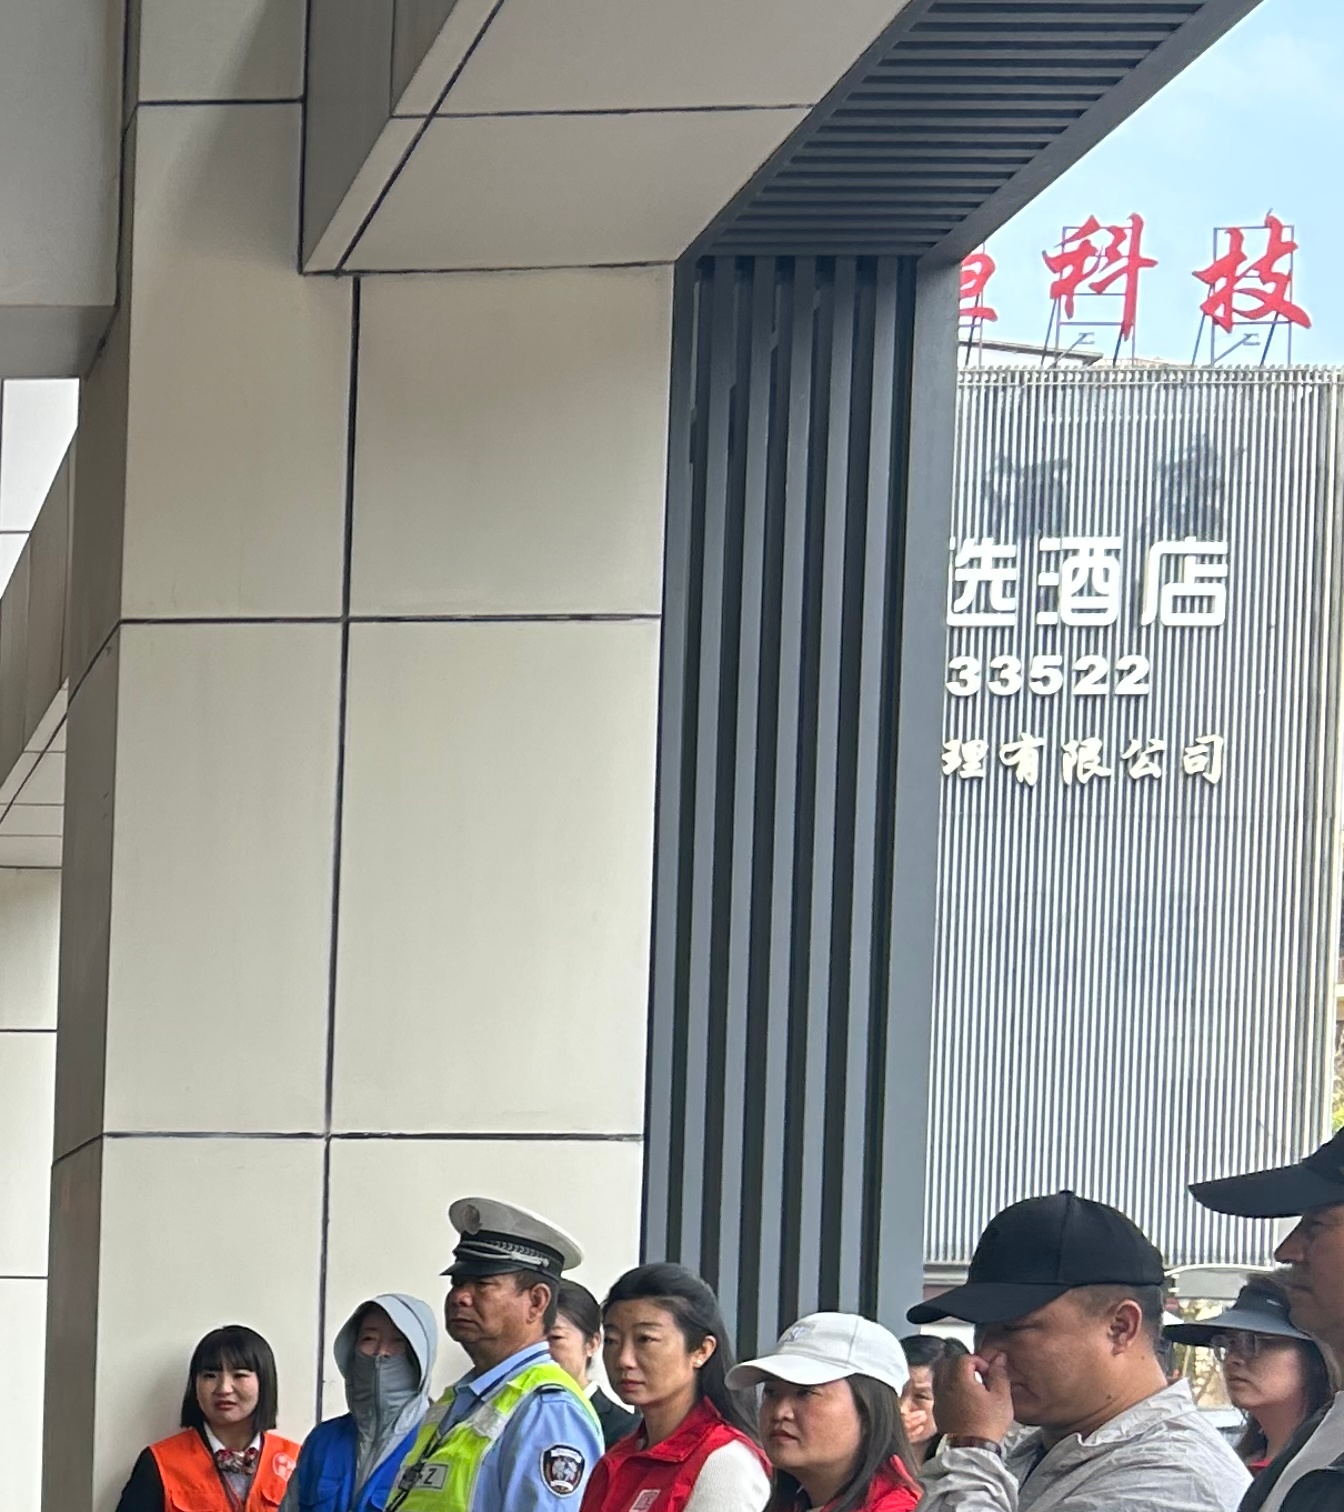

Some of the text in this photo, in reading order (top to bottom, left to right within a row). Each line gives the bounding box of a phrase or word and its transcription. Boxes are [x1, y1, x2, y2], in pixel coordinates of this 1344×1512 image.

[946, 535, 1229, 628] 选酒店
[945, 655, 1151, 697] 33522
[941, 732, 1226, 786] 理有限公司
